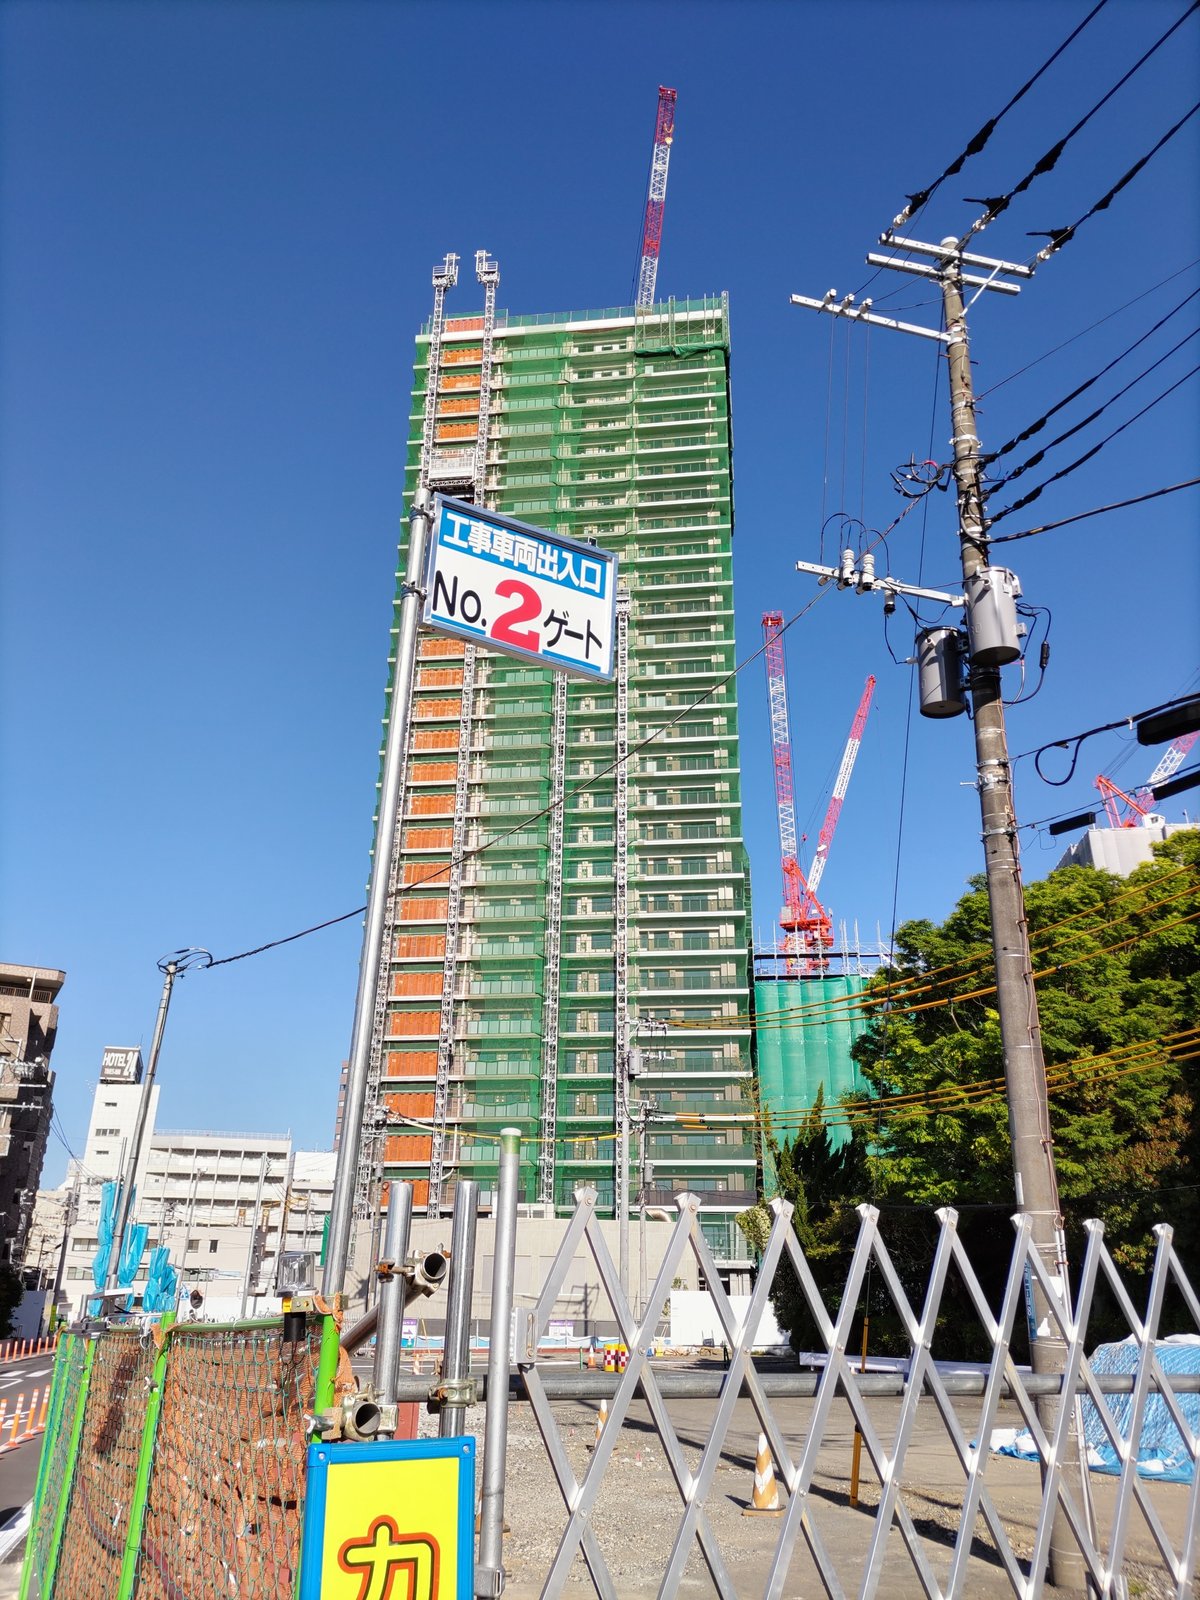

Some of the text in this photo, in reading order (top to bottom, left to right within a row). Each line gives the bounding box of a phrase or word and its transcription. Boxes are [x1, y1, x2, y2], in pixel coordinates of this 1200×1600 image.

[443, 512, 601, 593] 工事車両出入口
[102, 1052, 126, 1067] HOTEL
